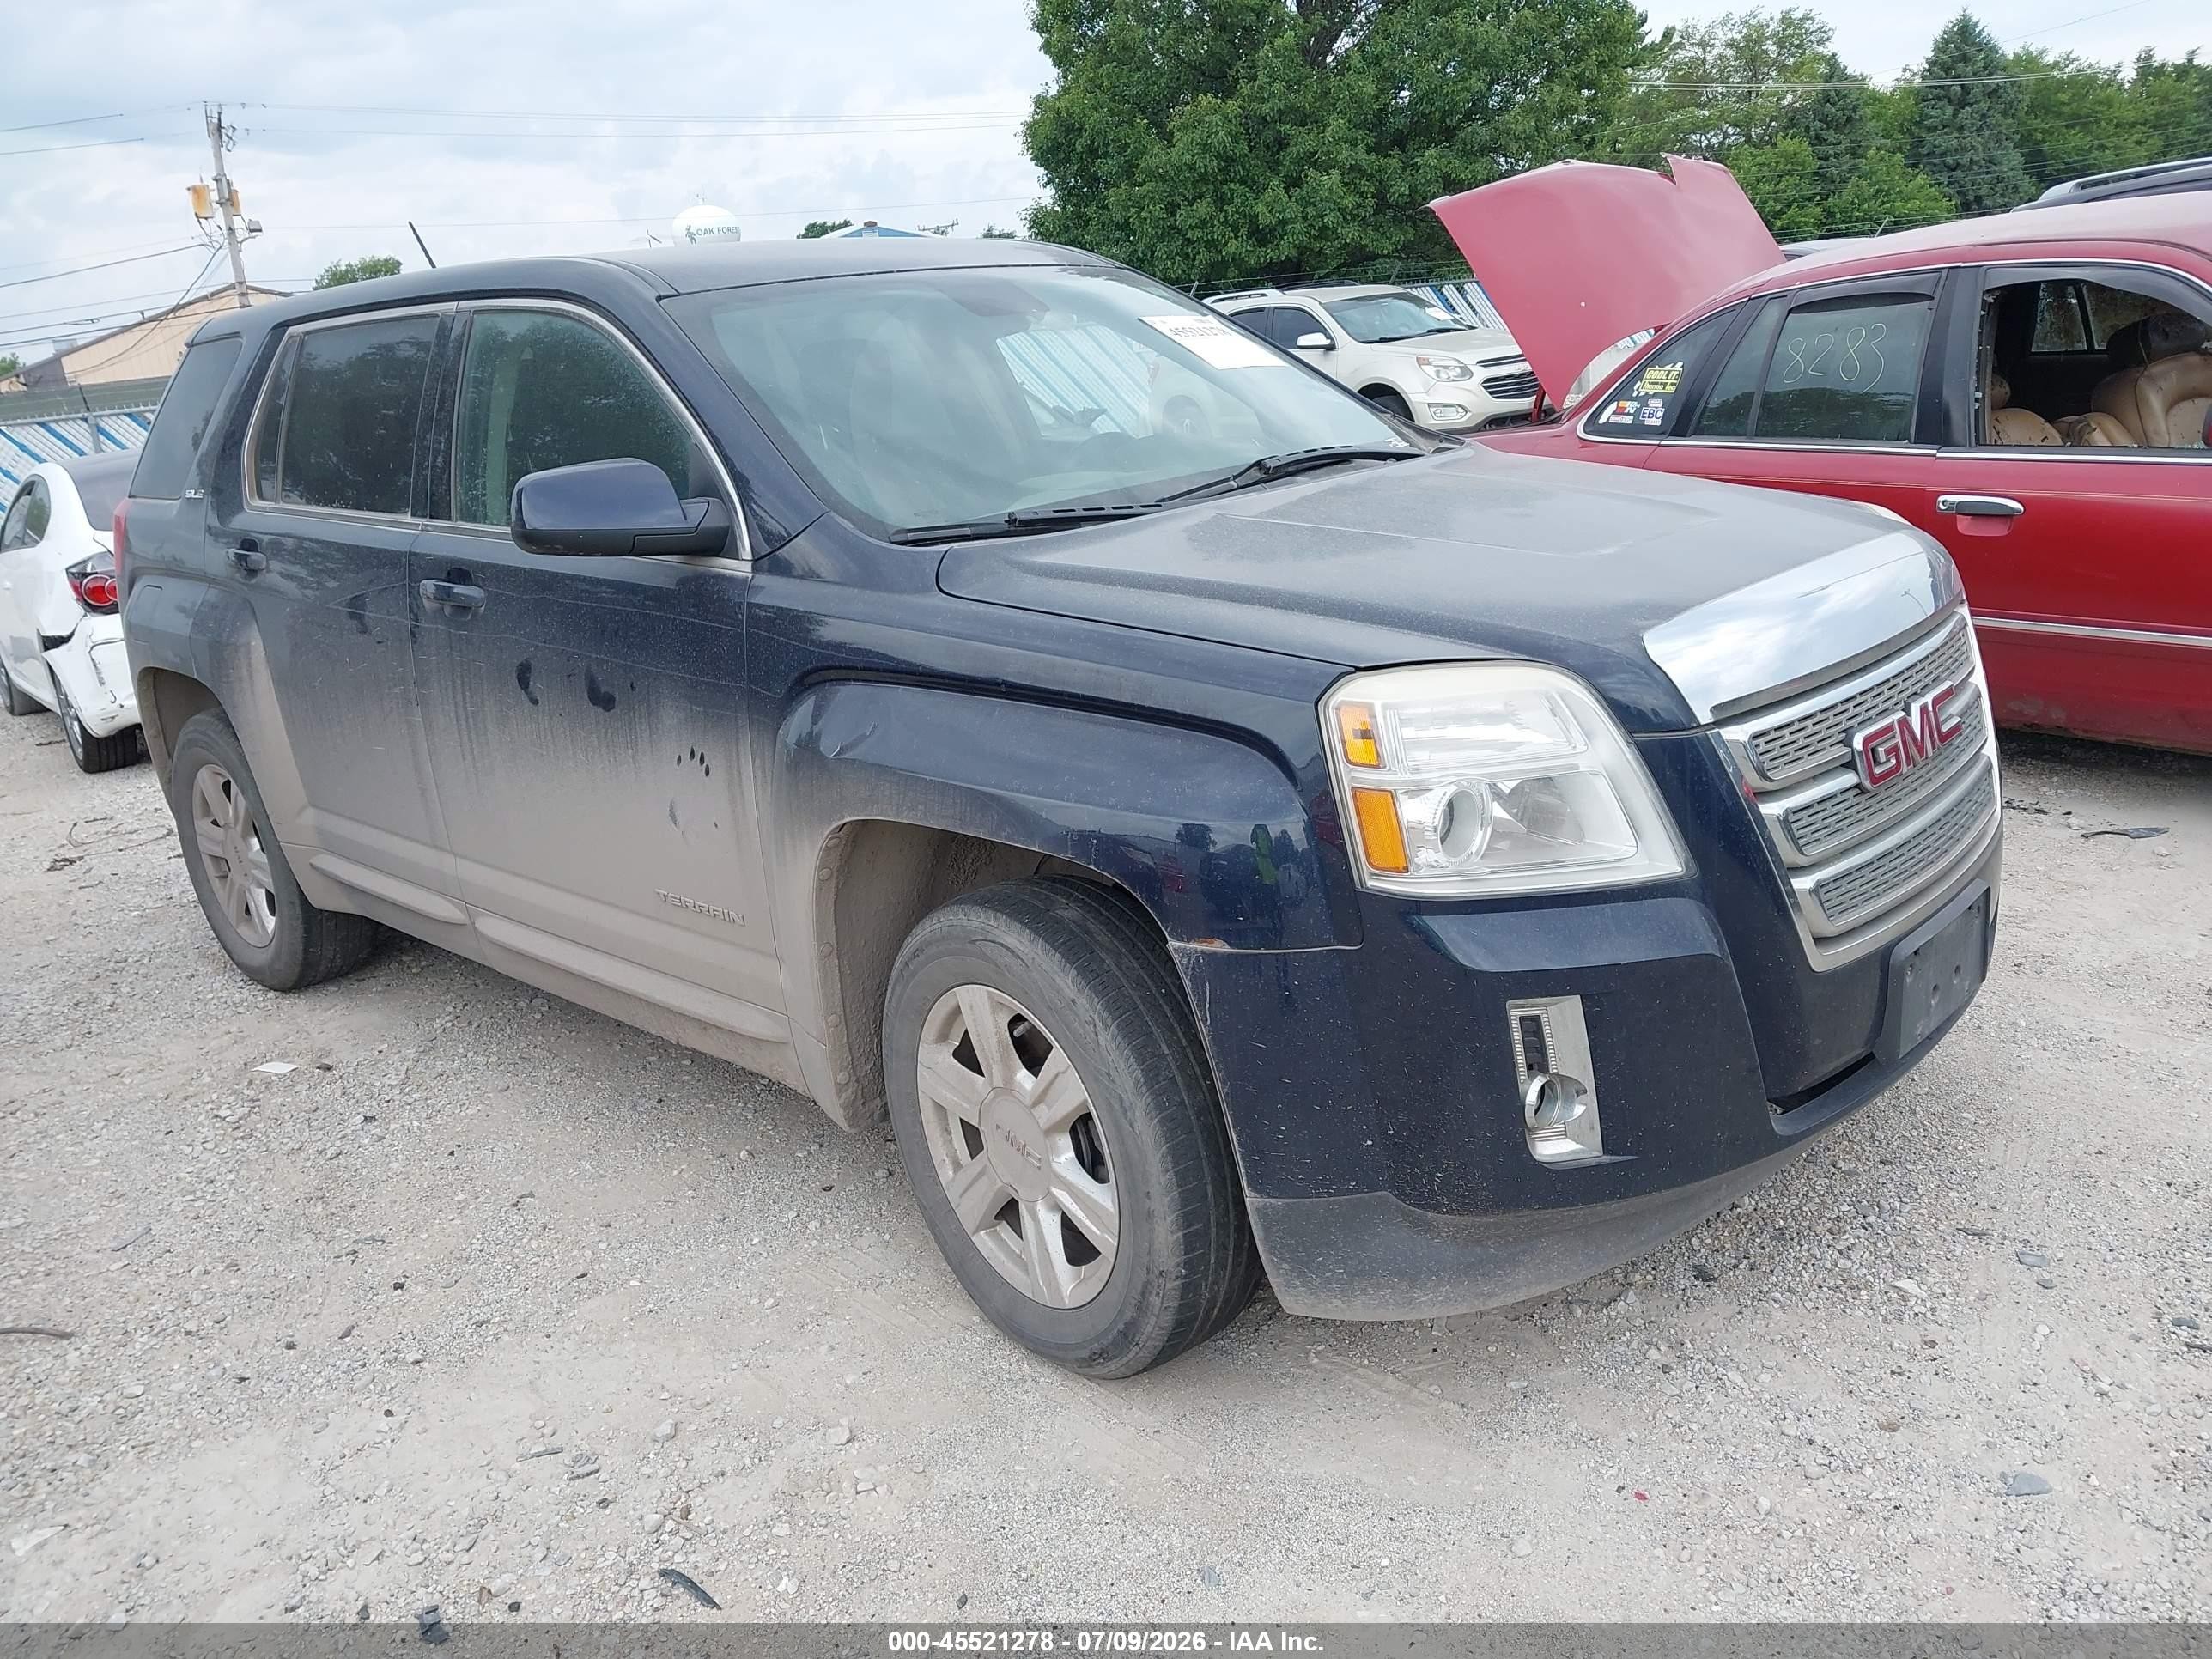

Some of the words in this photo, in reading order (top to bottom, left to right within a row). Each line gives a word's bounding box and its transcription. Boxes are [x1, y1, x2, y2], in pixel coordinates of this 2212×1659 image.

[696, 227, 715, 236] OAK
[1783, 323, 1887, 393] 8283
[1646, 369, 1667, 380] COOL
[1641, 408, 1663, 420] EBC
[1853, 680, 1964, 789] GMC
[654, 888, 747, 928] TERRAIN
